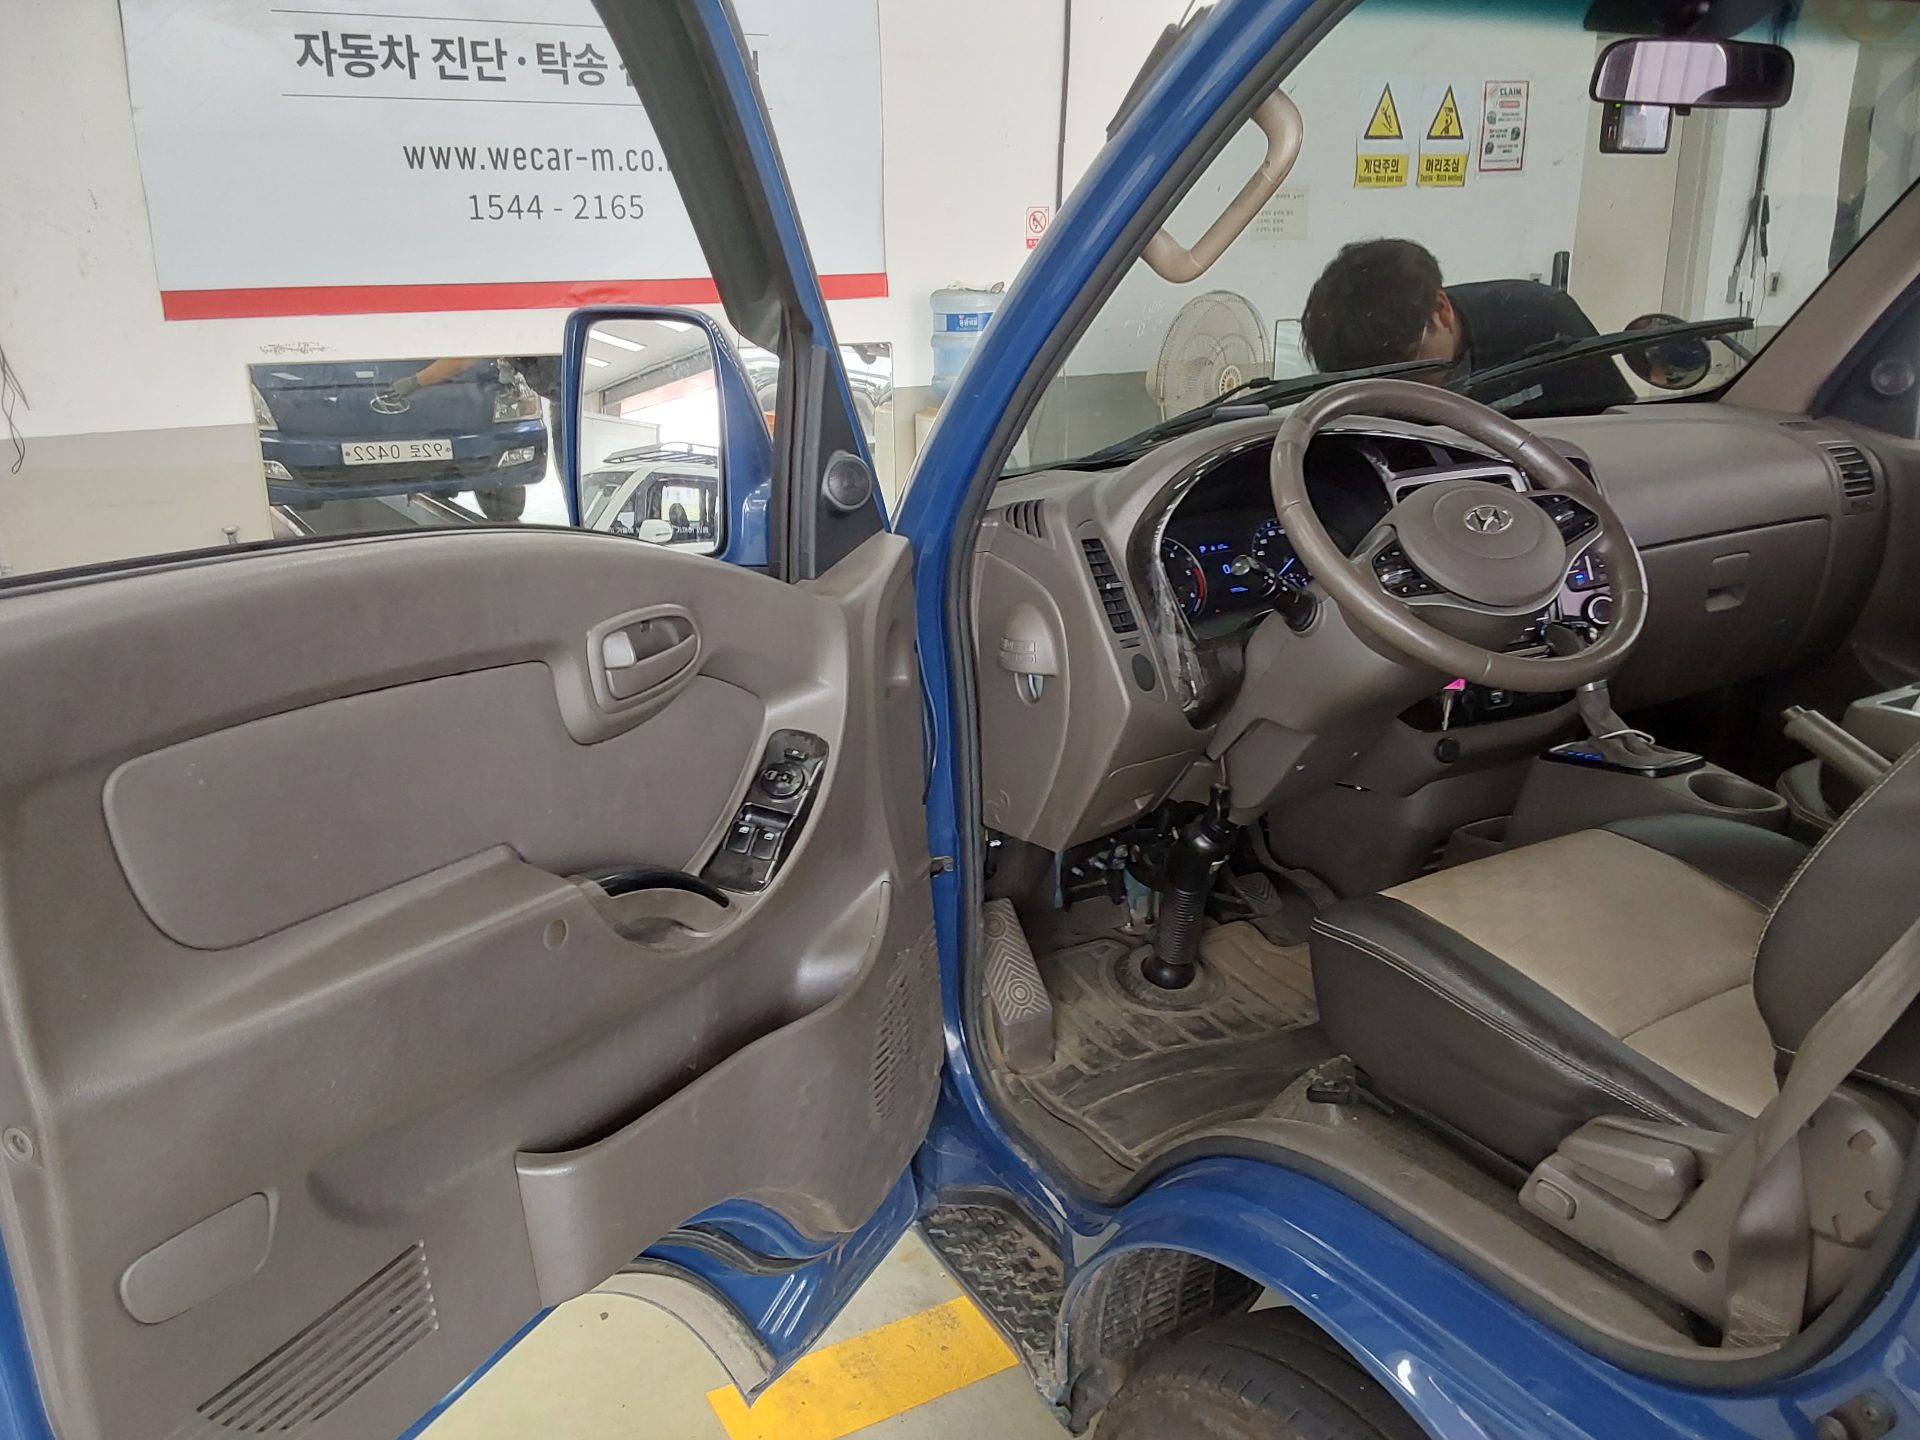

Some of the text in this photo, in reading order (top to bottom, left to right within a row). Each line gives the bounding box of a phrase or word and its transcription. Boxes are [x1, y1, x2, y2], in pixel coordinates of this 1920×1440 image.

[294, 29, 420, 80] 자동차
[1500, 87, 1522, 97] CLAIM
[403, 144, 671, 172] www.wecar-m.co.
[1363, 158, 1399, 174] 계단주의
[1425, 157, 1460, 173] 머리조심
